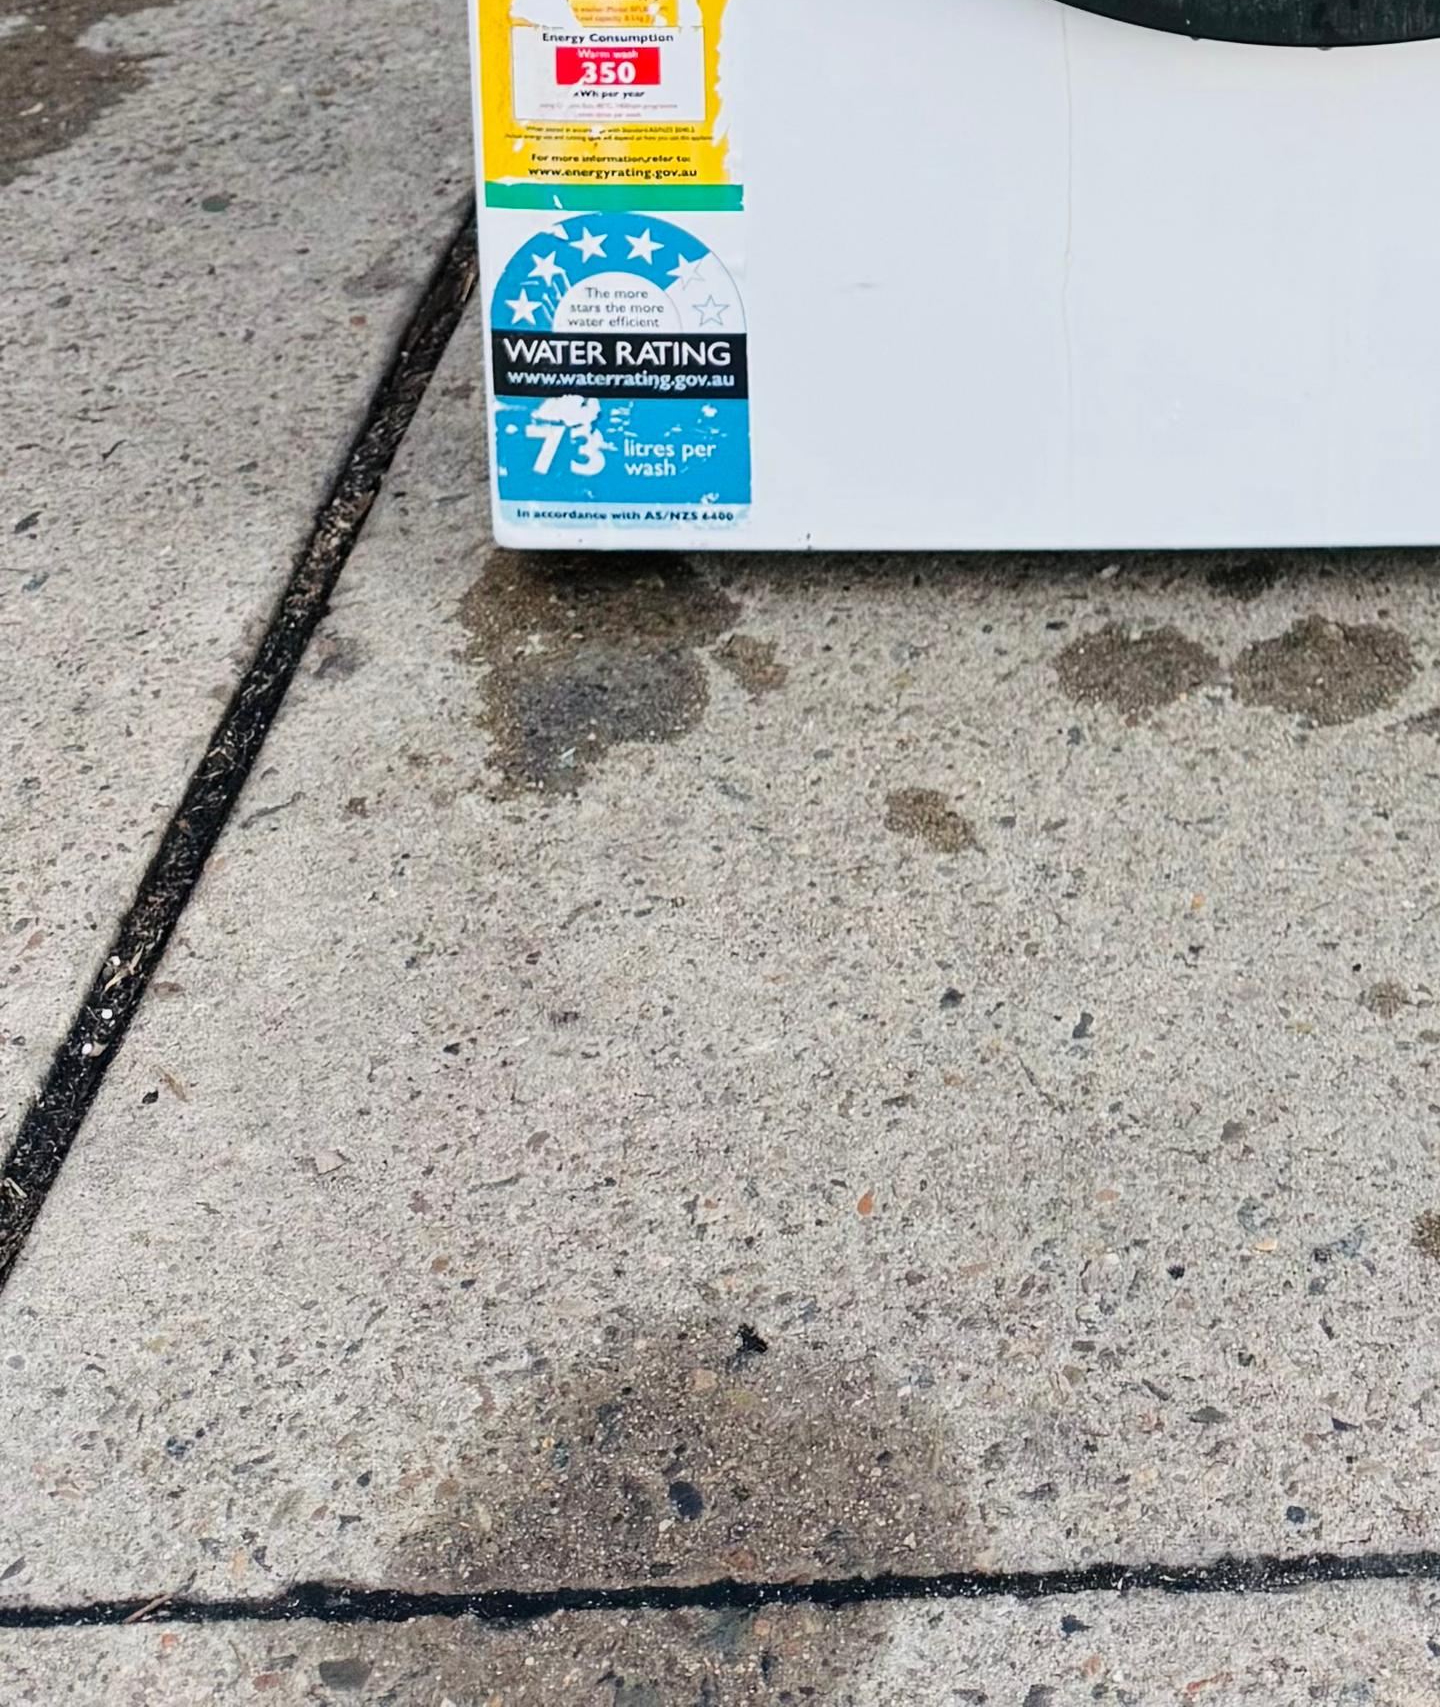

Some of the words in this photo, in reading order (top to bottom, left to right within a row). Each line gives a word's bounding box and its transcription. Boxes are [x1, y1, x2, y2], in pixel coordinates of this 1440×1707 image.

[542, 33, 585, 44] Energy
[589, 33, 674, 44] Consumption
[582, 62, 636, 84] 350
[600, 91, 619, 100] per
[623, 91, 645, 100] year
[531, 154, 548, 162] For
[528, 167, 697, 179] www.energyrating.gov.au
[585, 287, 610, 299] The
[614, 289, 648, 299] more
[570, 304, 601, 313] stars
[606, 303, 626, 313] the
[630, 305, 664, 314] more
[568, 318, 606, 327] water
[609, 317, 659, 327] efficient
[504, 338, 606, 365] WATER
[616, 341, 731, 366] RATING
[507, 370, 735, 390] www.waterrating.gov.au
[624, 439, 675, 458] litres
[682, 442, 716, 462] per
[624, 458, 676, 477] wash
[517, 509, 528, 518] In
[533, 510, 606, 519] accordance
[611, 510, 640, 519] with
[644, 510, 698, 521] AS/NZS
